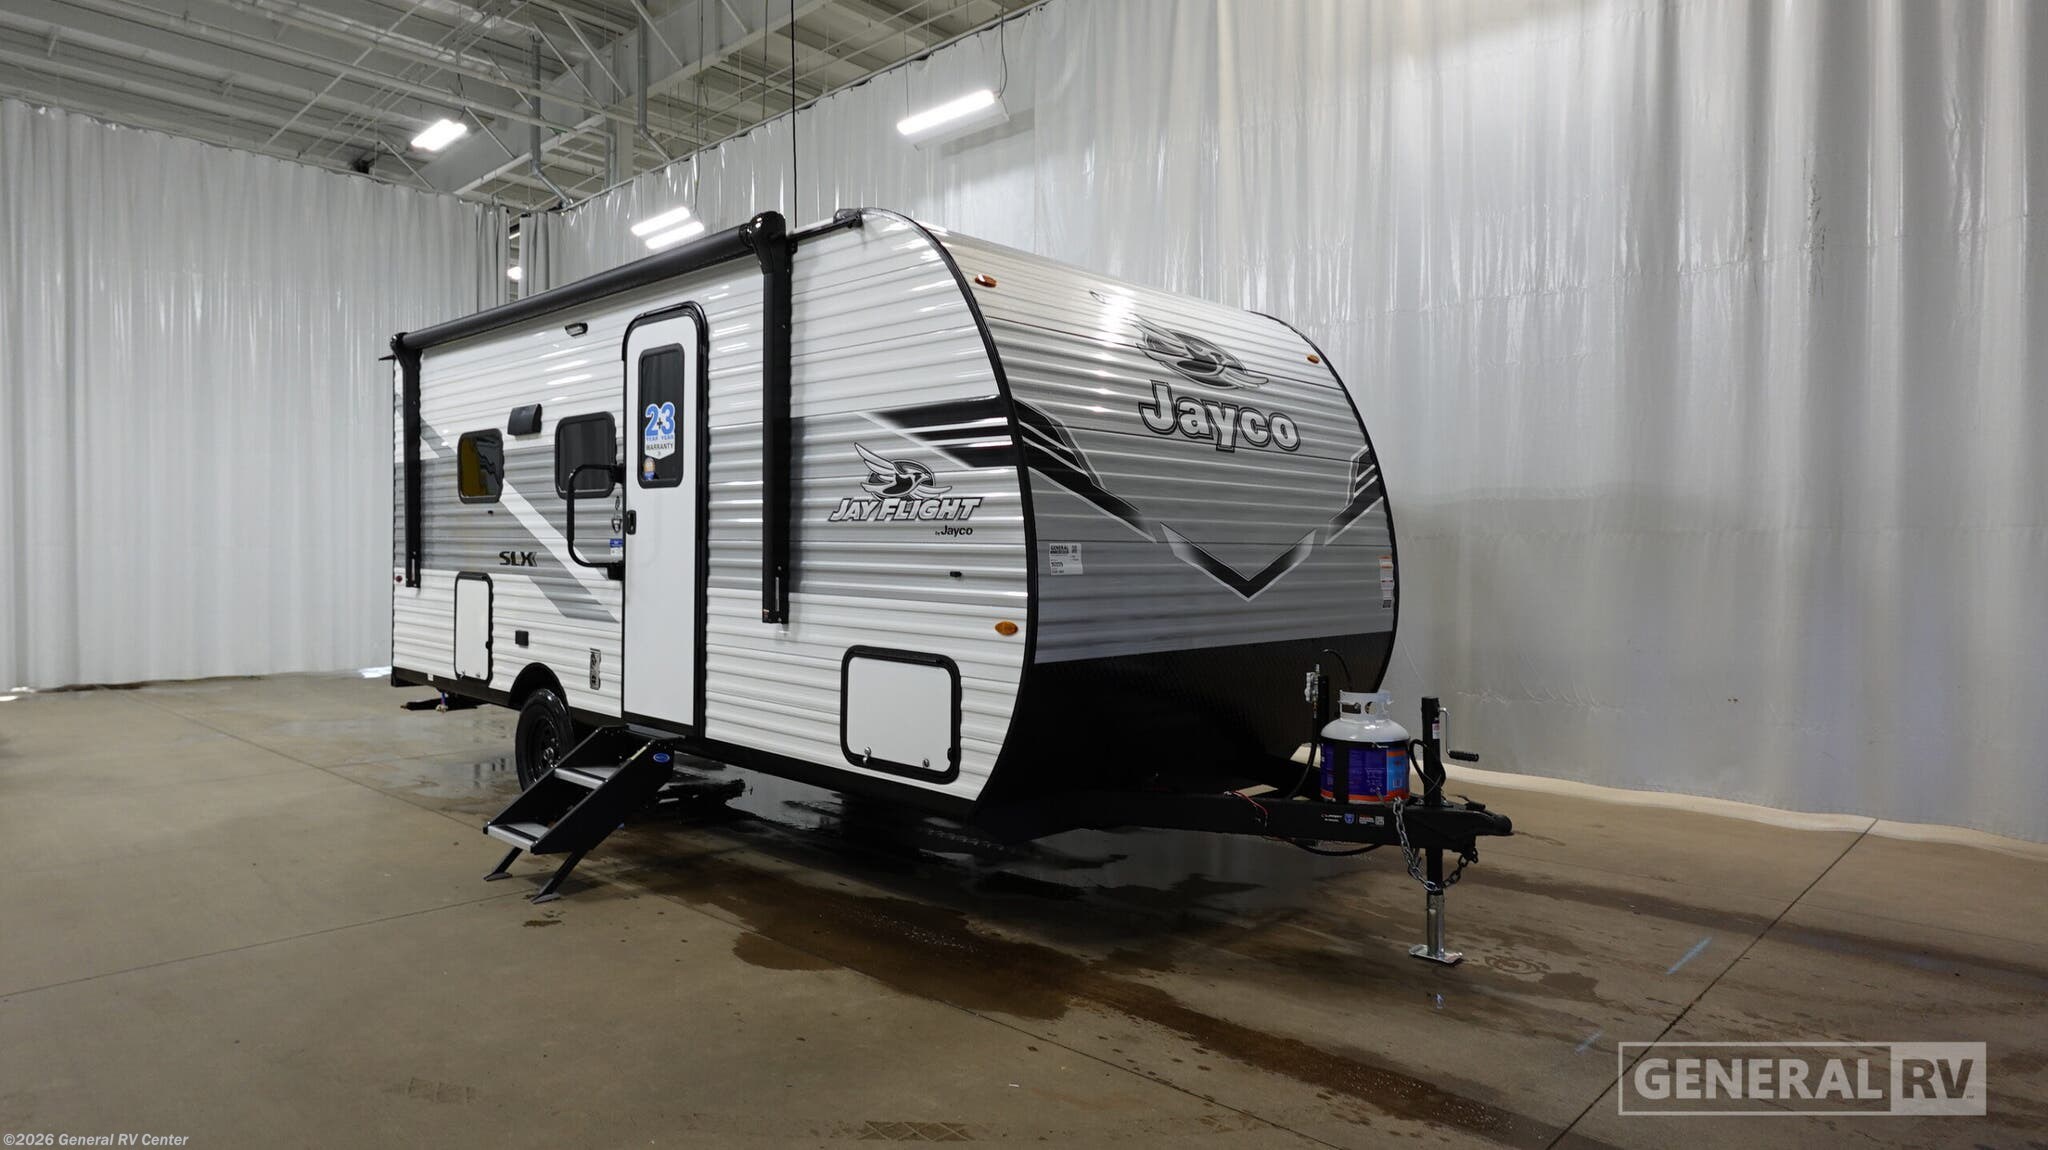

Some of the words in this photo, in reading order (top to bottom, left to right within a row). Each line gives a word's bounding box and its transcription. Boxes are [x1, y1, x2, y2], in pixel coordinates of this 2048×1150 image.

[1138, 379, 1301, 452] Jayco
[646, 442, 673, 450] WARRANTY
[828, 498, 882, 521] JAY
[874, 497, 985, 521] FLIGHT
[941, 525, 973, 537] Jayco
[499, 551, 536, 567] SLX
